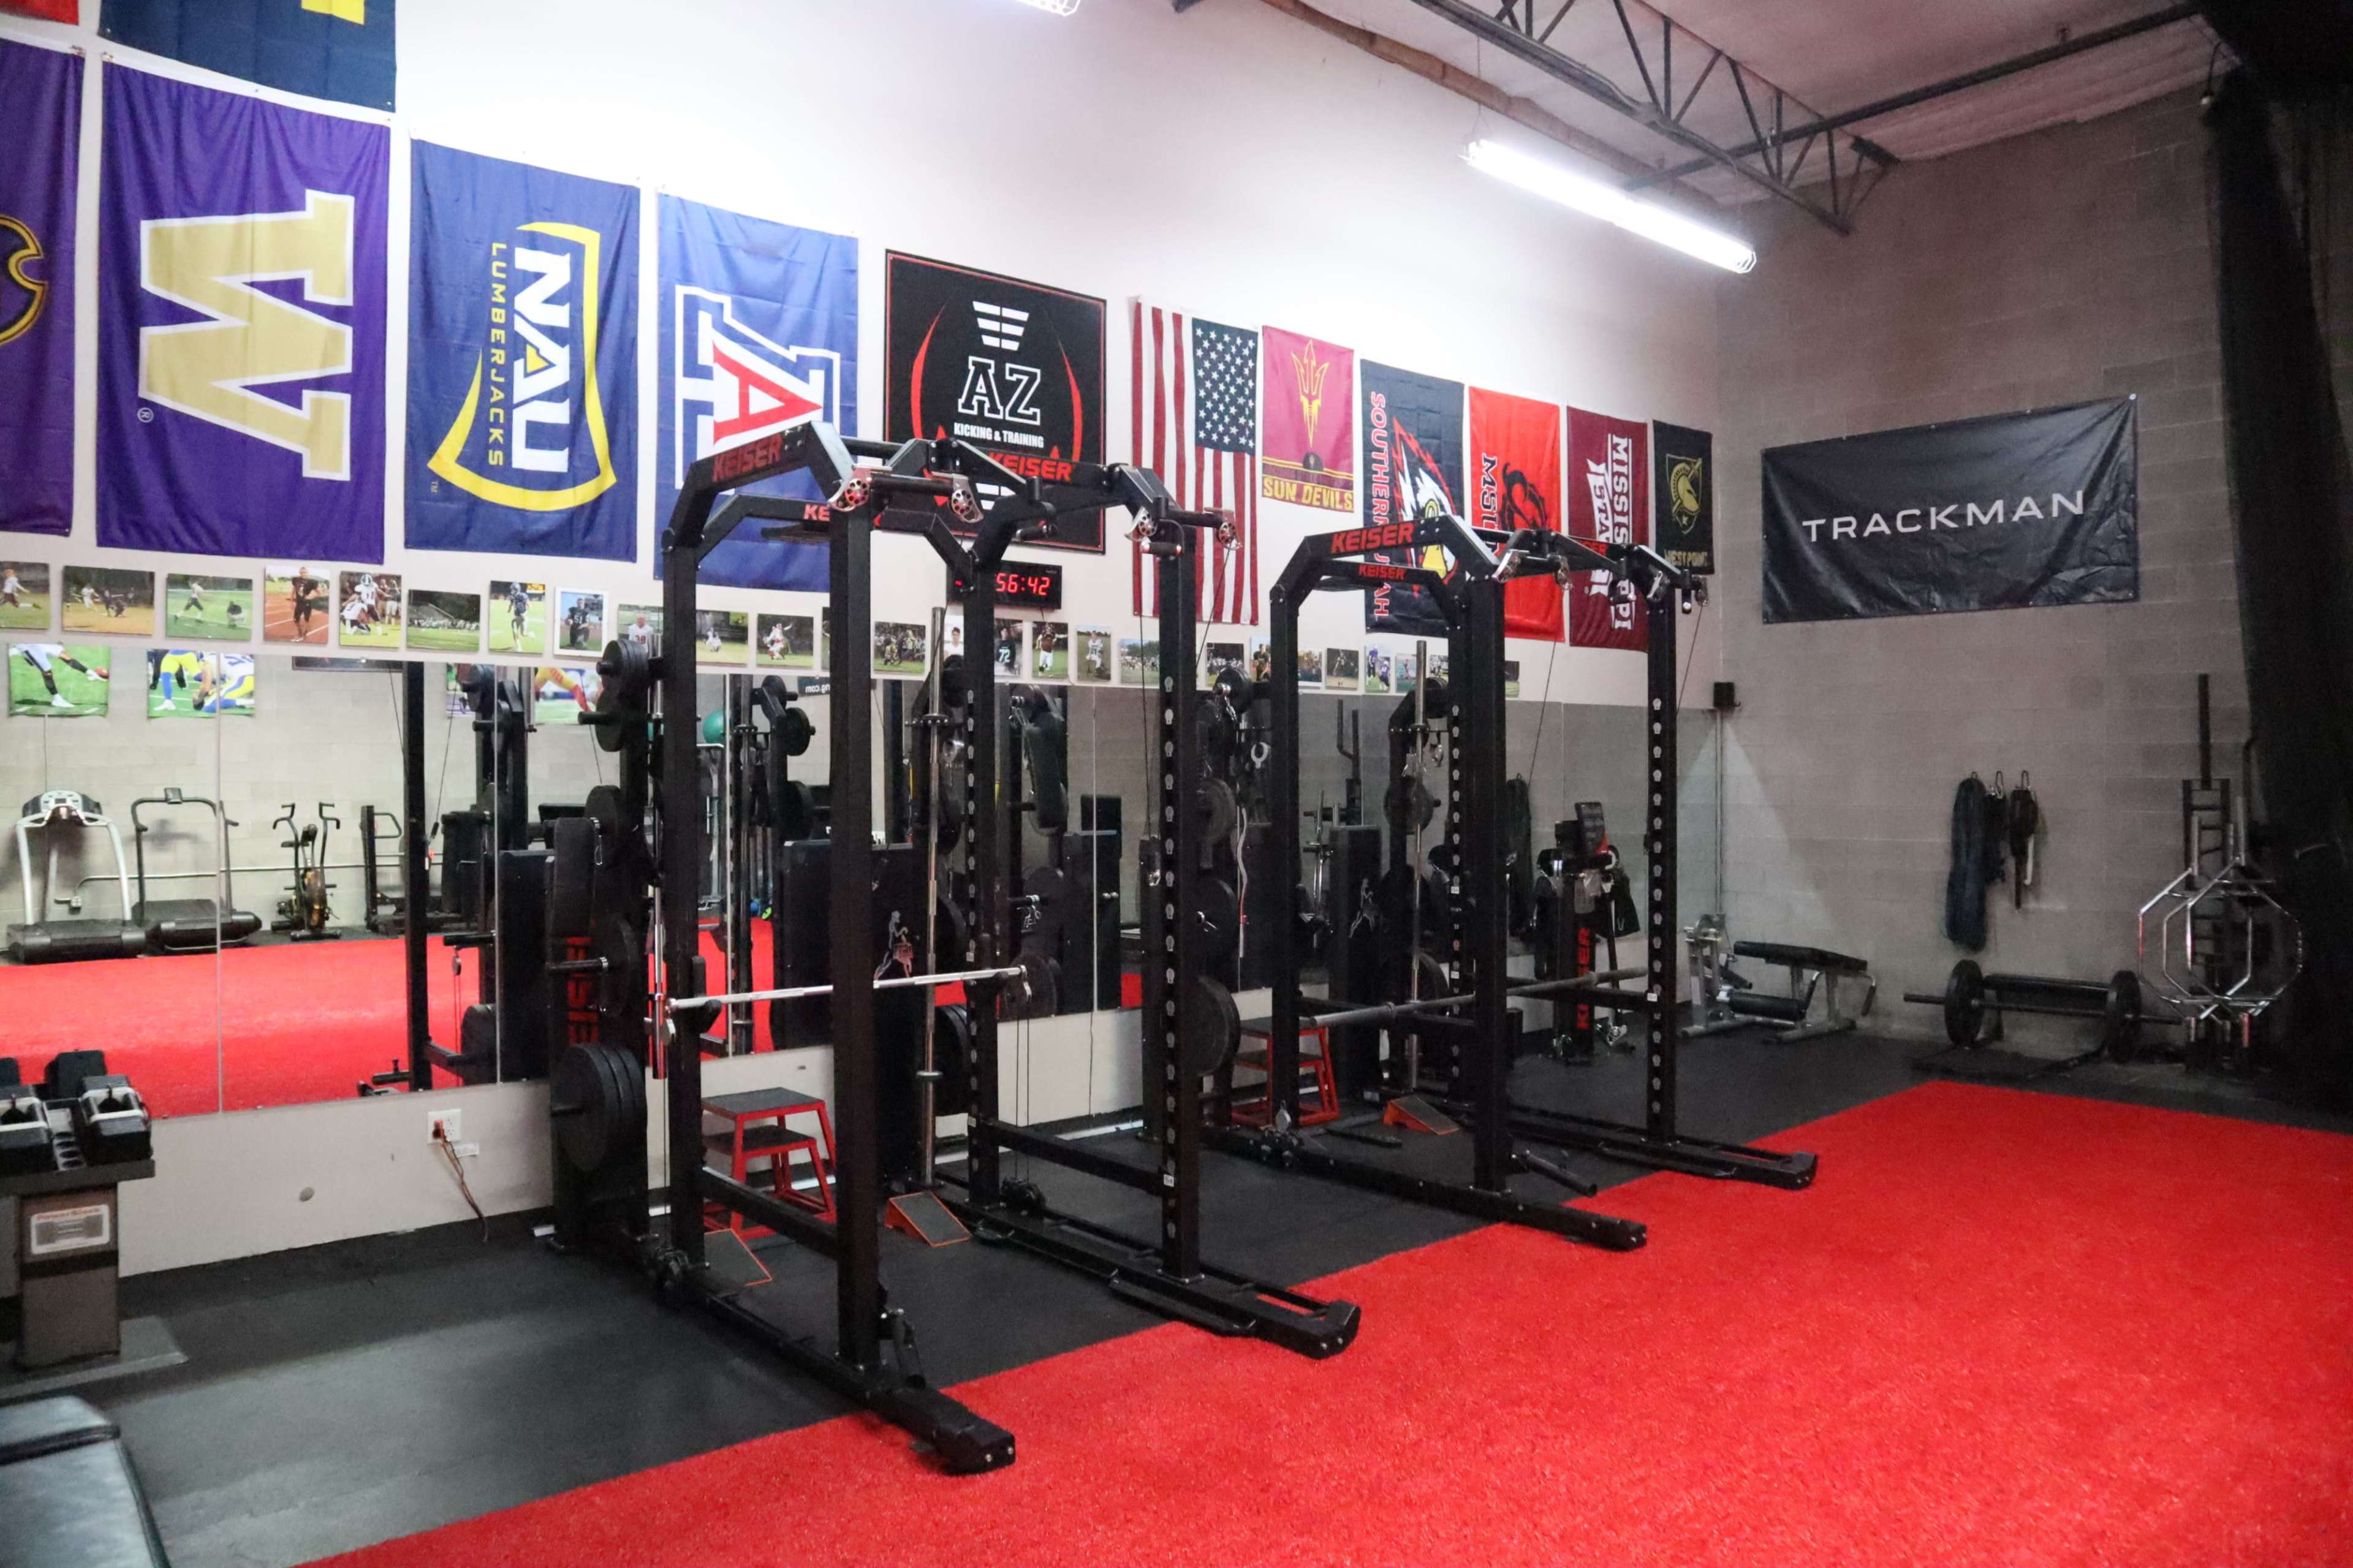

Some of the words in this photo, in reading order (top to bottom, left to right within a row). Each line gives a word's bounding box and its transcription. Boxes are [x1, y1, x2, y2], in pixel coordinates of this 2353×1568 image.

[138, 189, 355, 481] W
[487, 241, 508, 467] LUMBERJACKS
[512, 247, 570, 473] NAU
[675, 284, 841, 494] A
[958, 355, 1042, 426] AZ
[713, 433, 783, 482] KEISER
[953, 422, 993, 441] KICKING
[993, 431, 1001, 442] &
[1002, 430, 1044, 449] TRAINING
[1264, 476, 1297, 501] SUN
[1302, 484, 1353, 511] DEVILS
[1802, 490, 2084, 542] TRACKMAN
[1330, 522, 1415, 554] KEISER
[1612, 434, 1632, 629] MISSISPPI
[996, 572, 1051, 597] 56:42
[1358, 564, 1407, 580] KEISER
[998, 648, 1010, 663] 72
